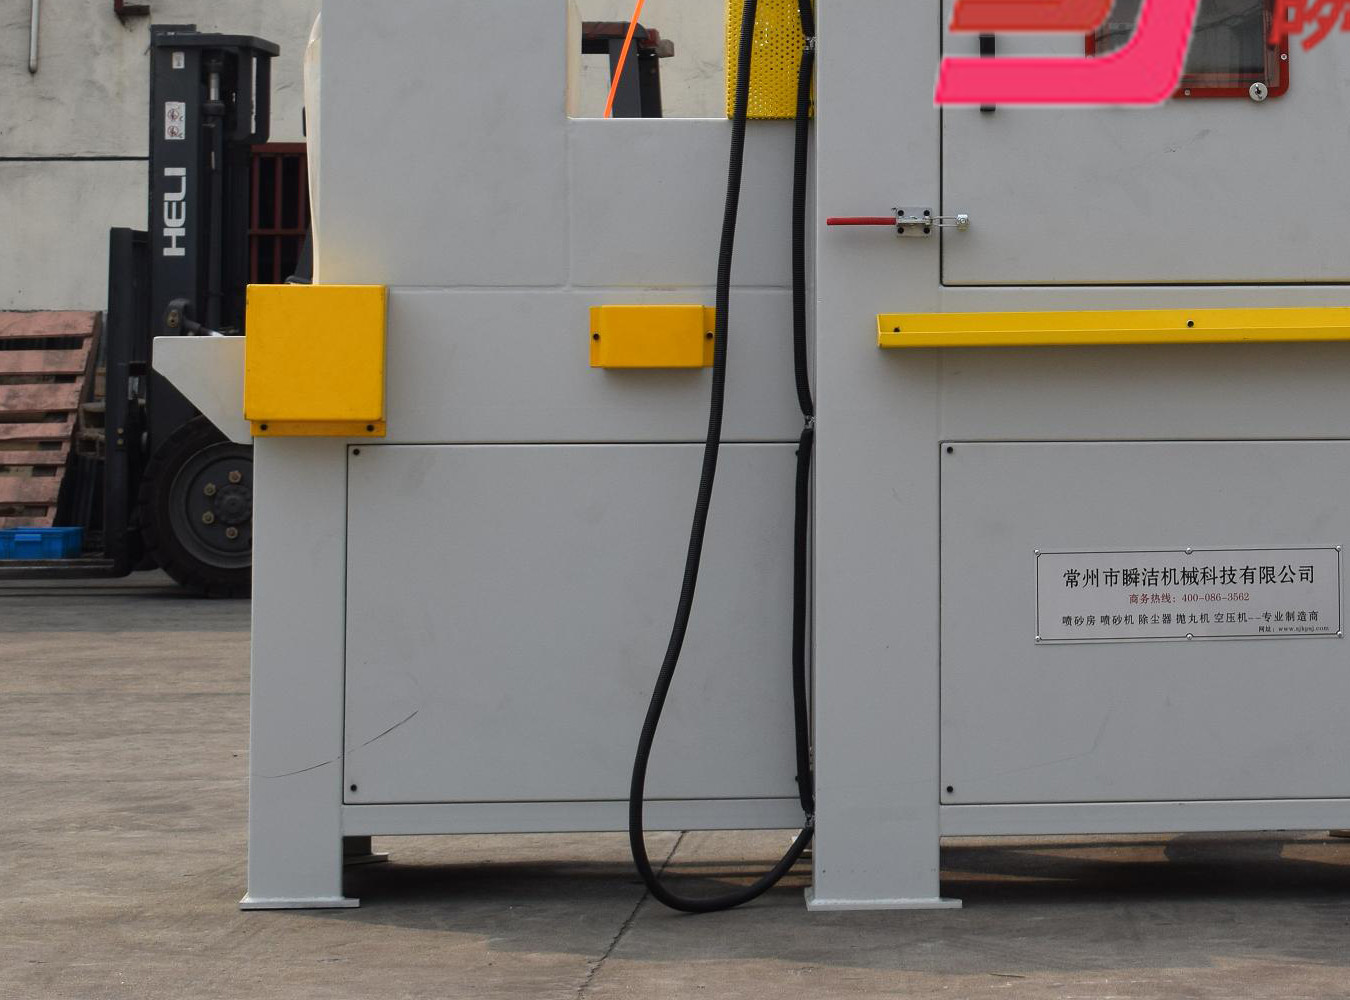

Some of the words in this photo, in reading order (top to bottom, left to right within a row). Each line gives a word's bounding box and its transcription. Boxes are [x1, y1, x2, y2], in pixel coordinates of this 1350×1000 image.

[163, 167, 187, 256] HELI
[1062, 564, 1315, 589] 常州市瞬洁机械科技有限公司
[1180, 592, 1251, 603] 400-086-3562
[1061, 614, 1096, 627] 喷砂房
[1100, 614, 1135, 626] 喷砂机
[1138, 613, 1172, 625] 除尘器
